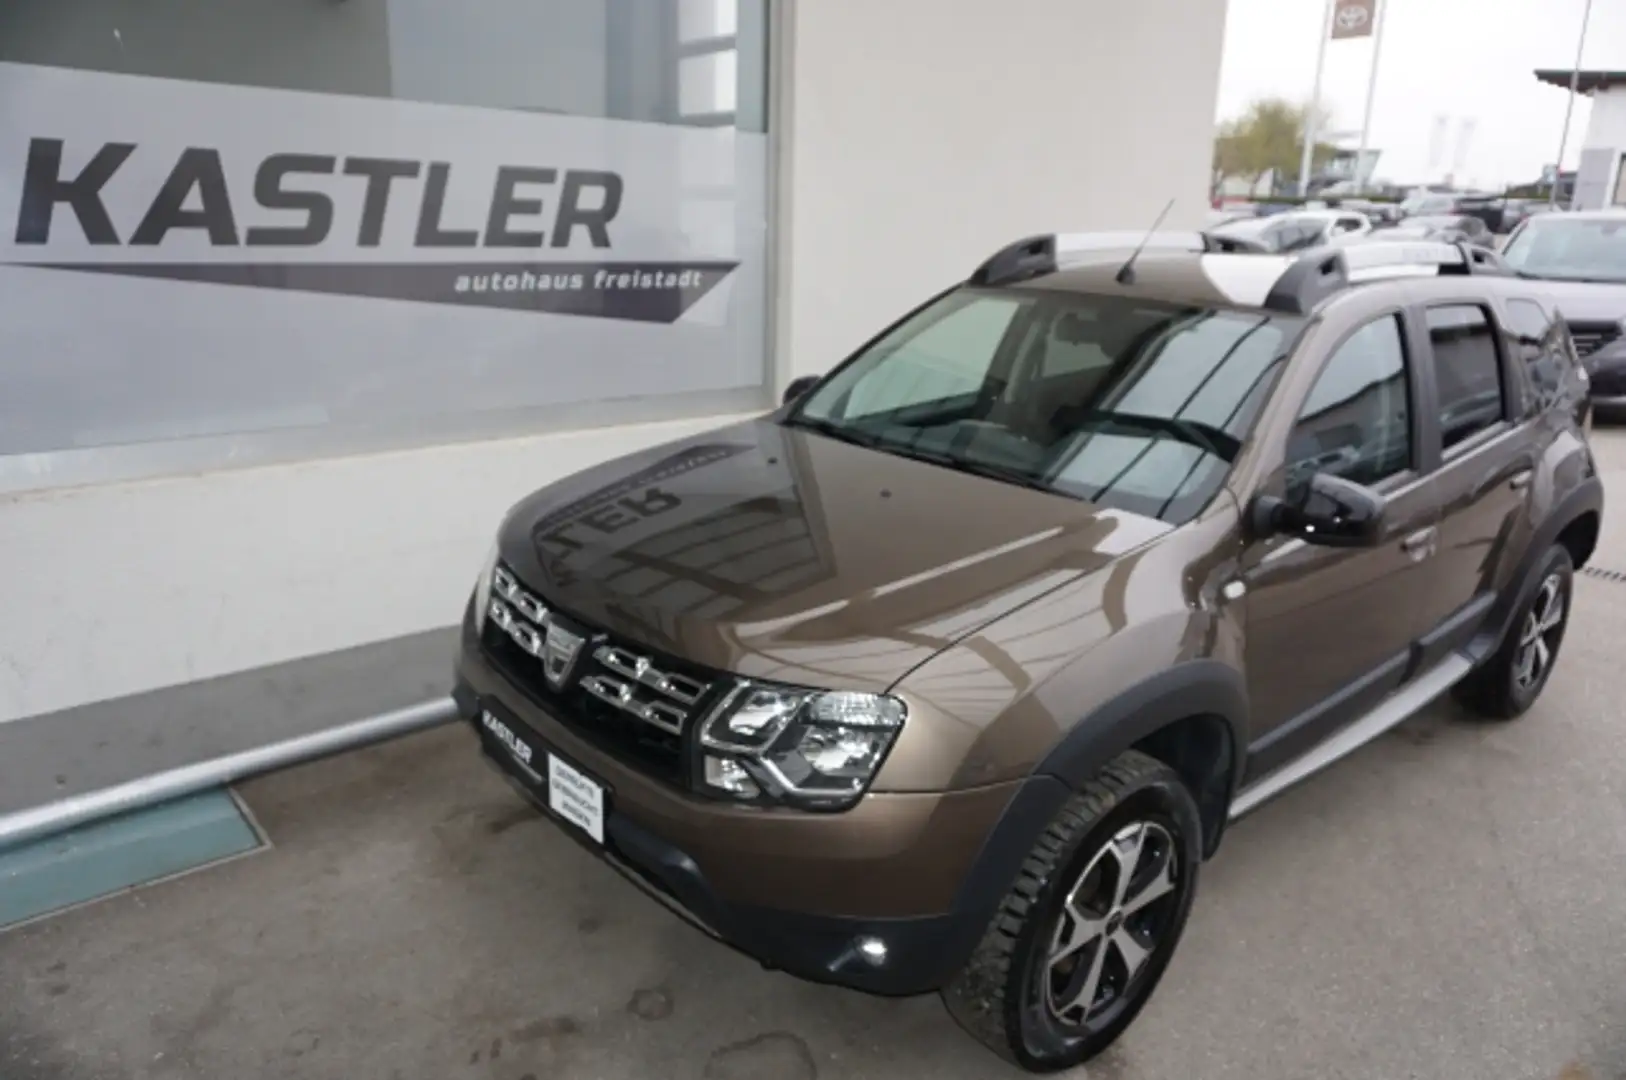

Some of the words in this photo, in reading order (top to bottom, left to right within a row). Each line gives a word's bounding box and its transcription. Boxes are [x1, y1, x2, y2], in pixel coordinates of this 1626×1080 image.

[14, 137, 625, 248] KASTLER
[454, 271, 584, 292] autohaus
[593, 269, 703, 290] freistadt
